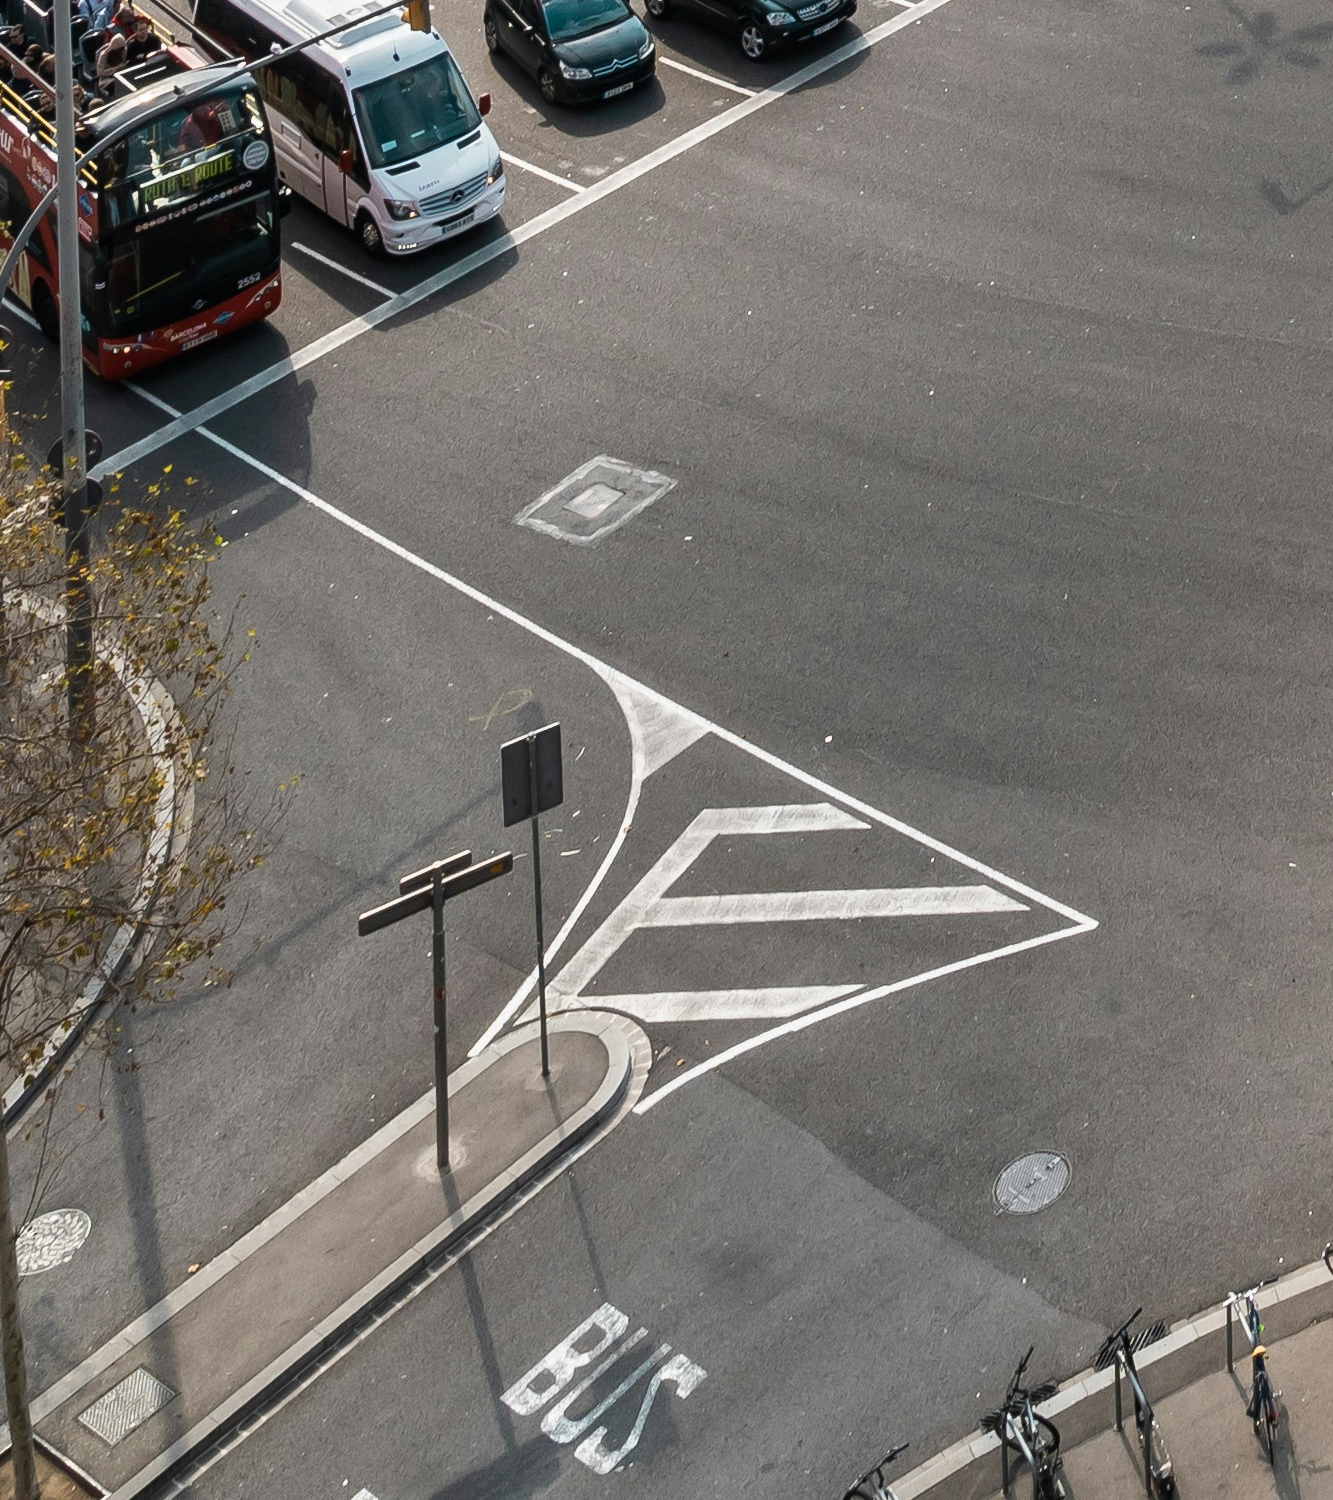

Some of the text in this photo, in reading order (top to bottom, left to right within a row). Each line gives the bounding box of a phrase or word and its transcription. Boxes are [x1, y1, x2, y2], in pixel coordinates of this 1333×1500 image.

[195, 154, 232, 183] ROUTE
[238, 271, 261, 290] 2552
[500, 1302, 708, 1475] BUS
